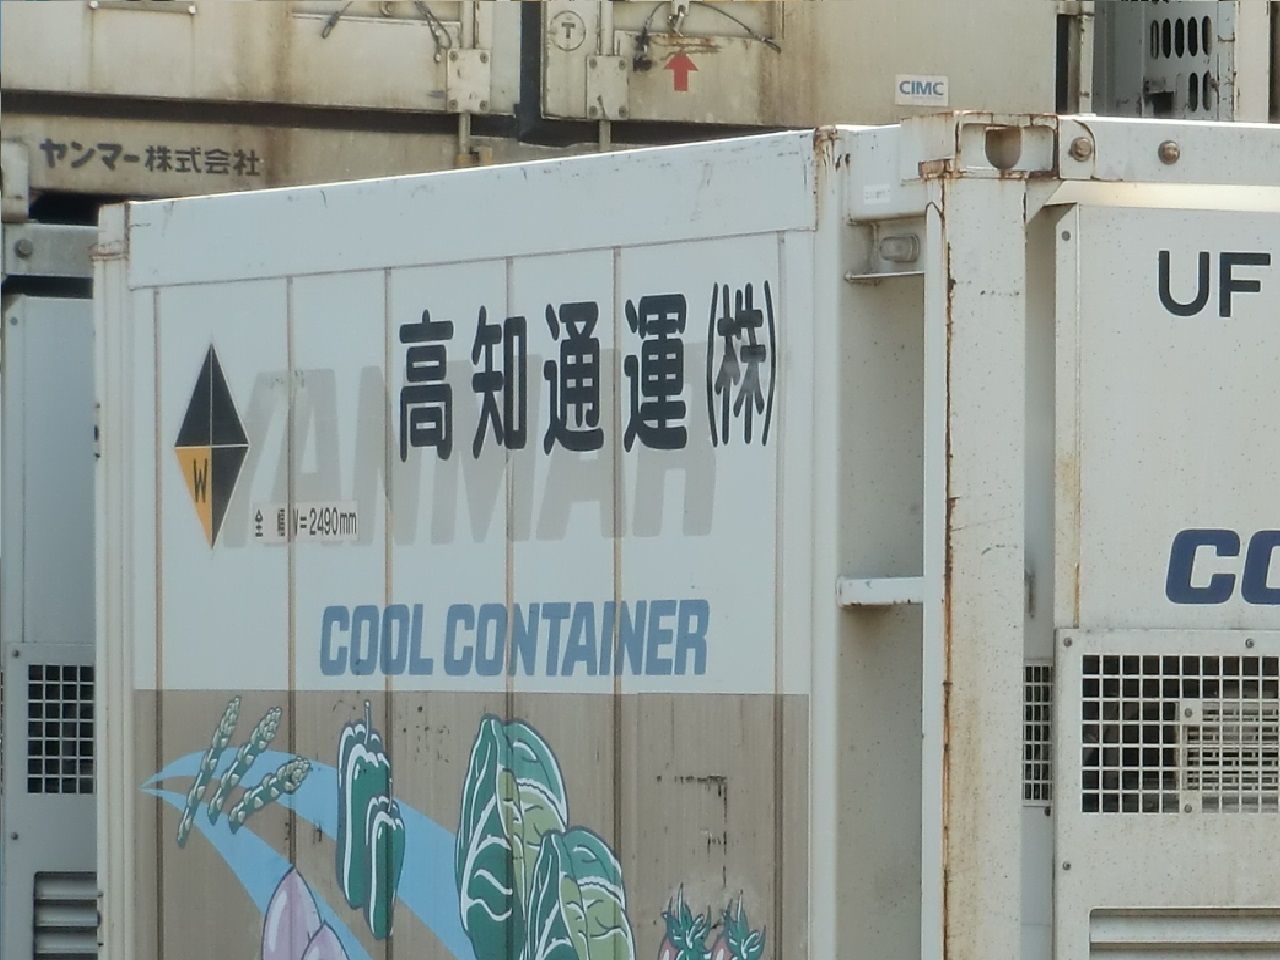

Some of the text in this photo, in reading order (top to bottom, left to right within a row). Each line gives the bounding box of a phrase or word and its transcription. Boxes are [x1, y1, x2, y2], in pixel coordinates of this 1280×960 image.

[899, 80, 944, 96] CIMC
[39, 138, 261, 177] ヤンマー株式会社
[399, 280, 777, 462] 高知通運(株)
[193, 458, 209, 504] W
[319, 598, 710, 677] COOL CONTAINER
